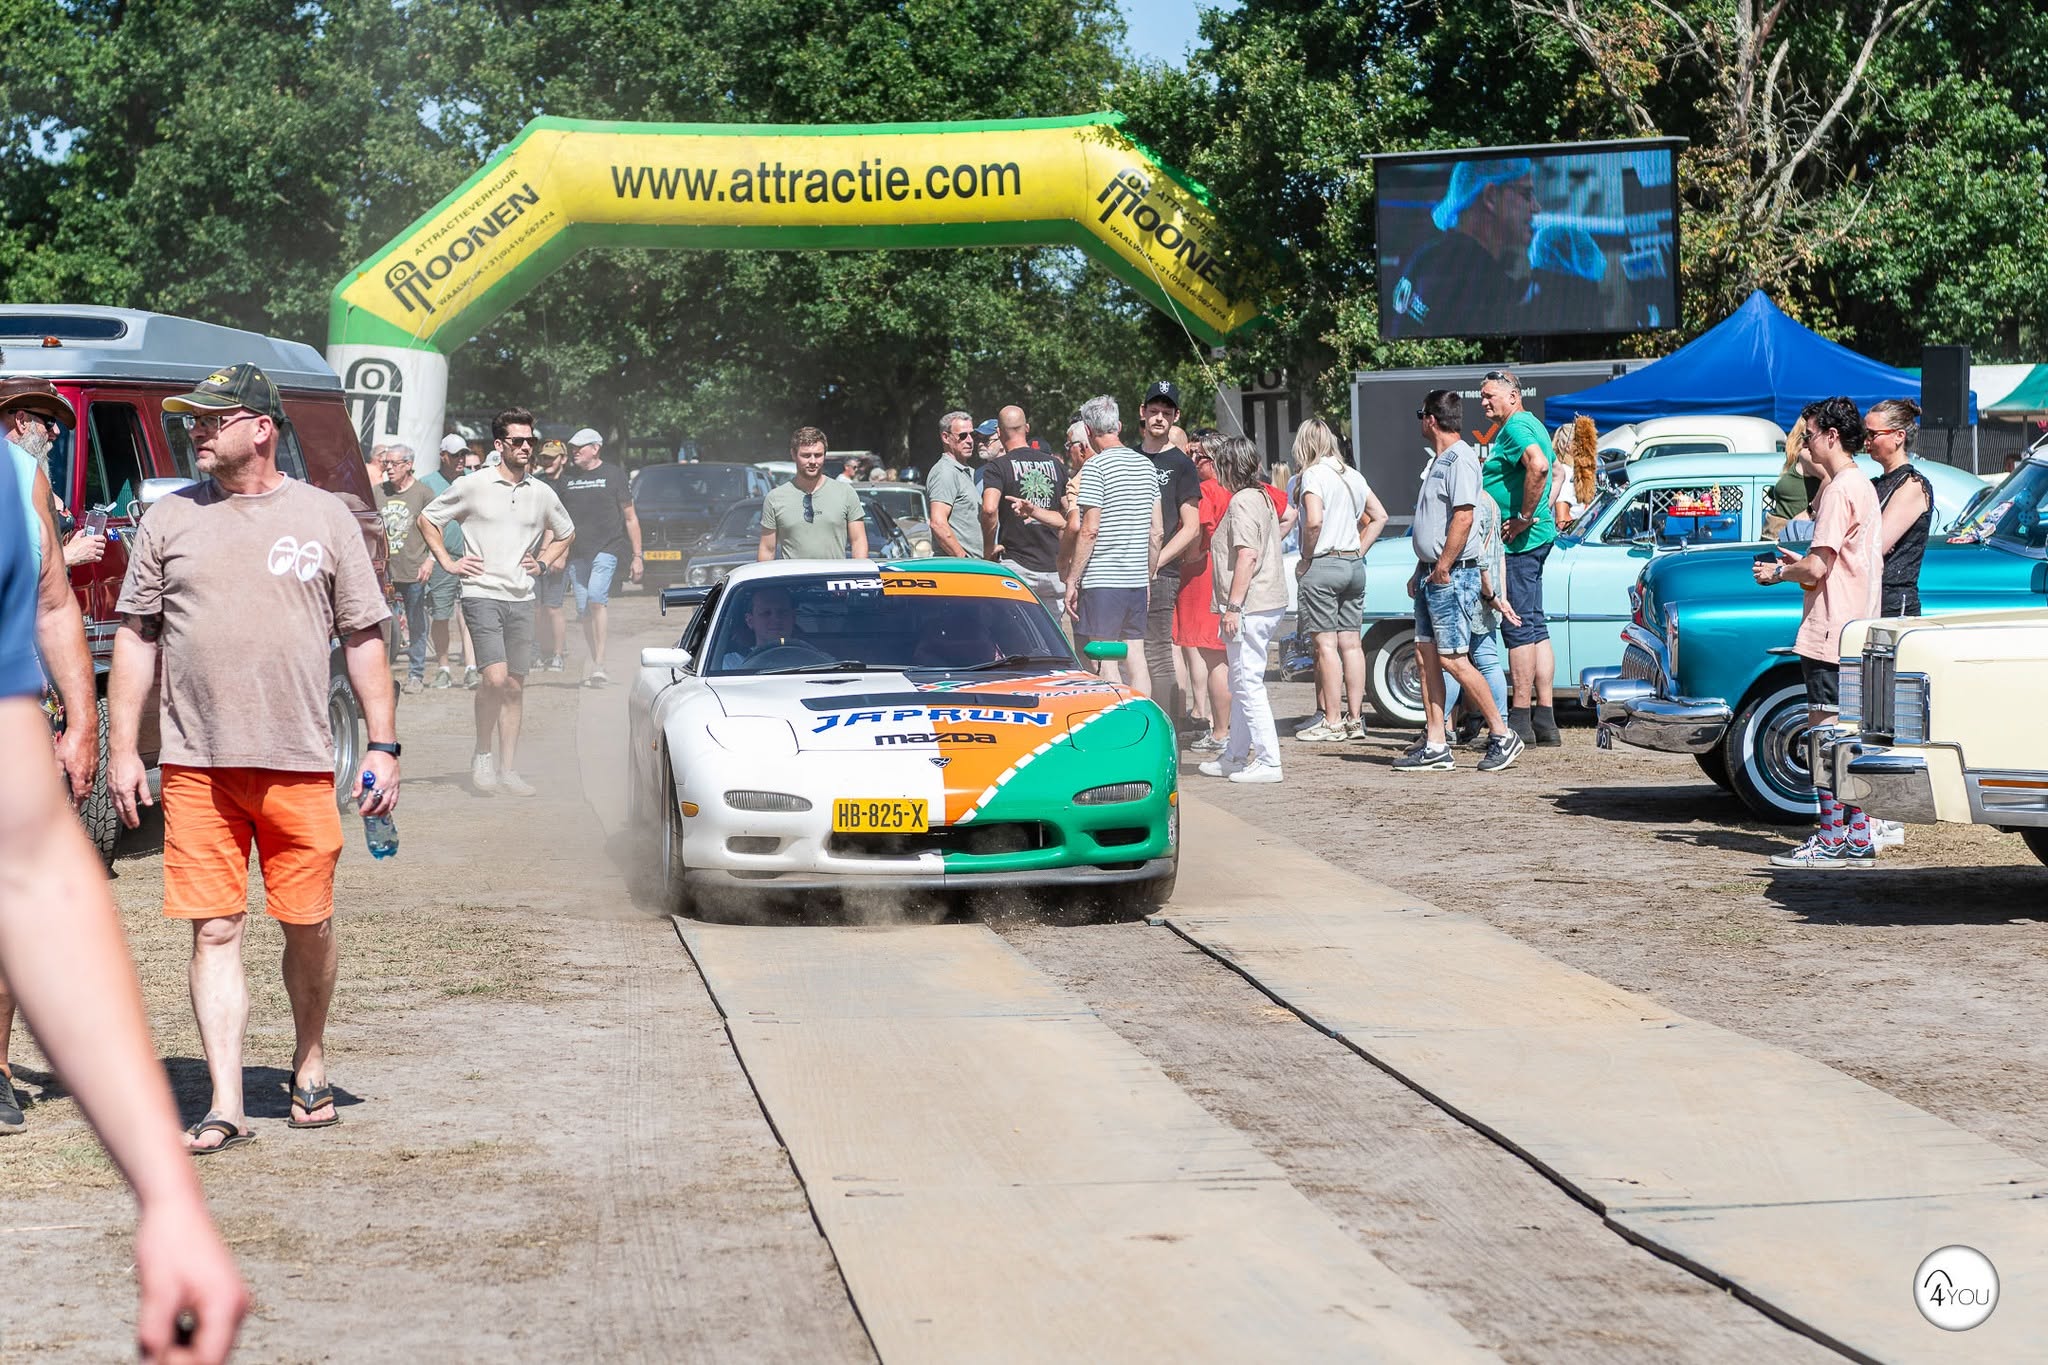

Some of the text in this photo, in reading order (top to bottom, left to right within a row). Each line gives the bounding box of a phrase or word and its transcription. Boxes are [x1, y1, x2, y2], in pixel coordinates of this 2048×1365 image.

[611, 158, 1021, 203] www.attractie.com
[415, 169, 519, 256] ATTRACTIEVERHUUR
[1096, 168, 1238, 296] MOONE
[812, 708, 1050, 733] JAPRUN
[838, 803, 924, 828] HB-825-X
